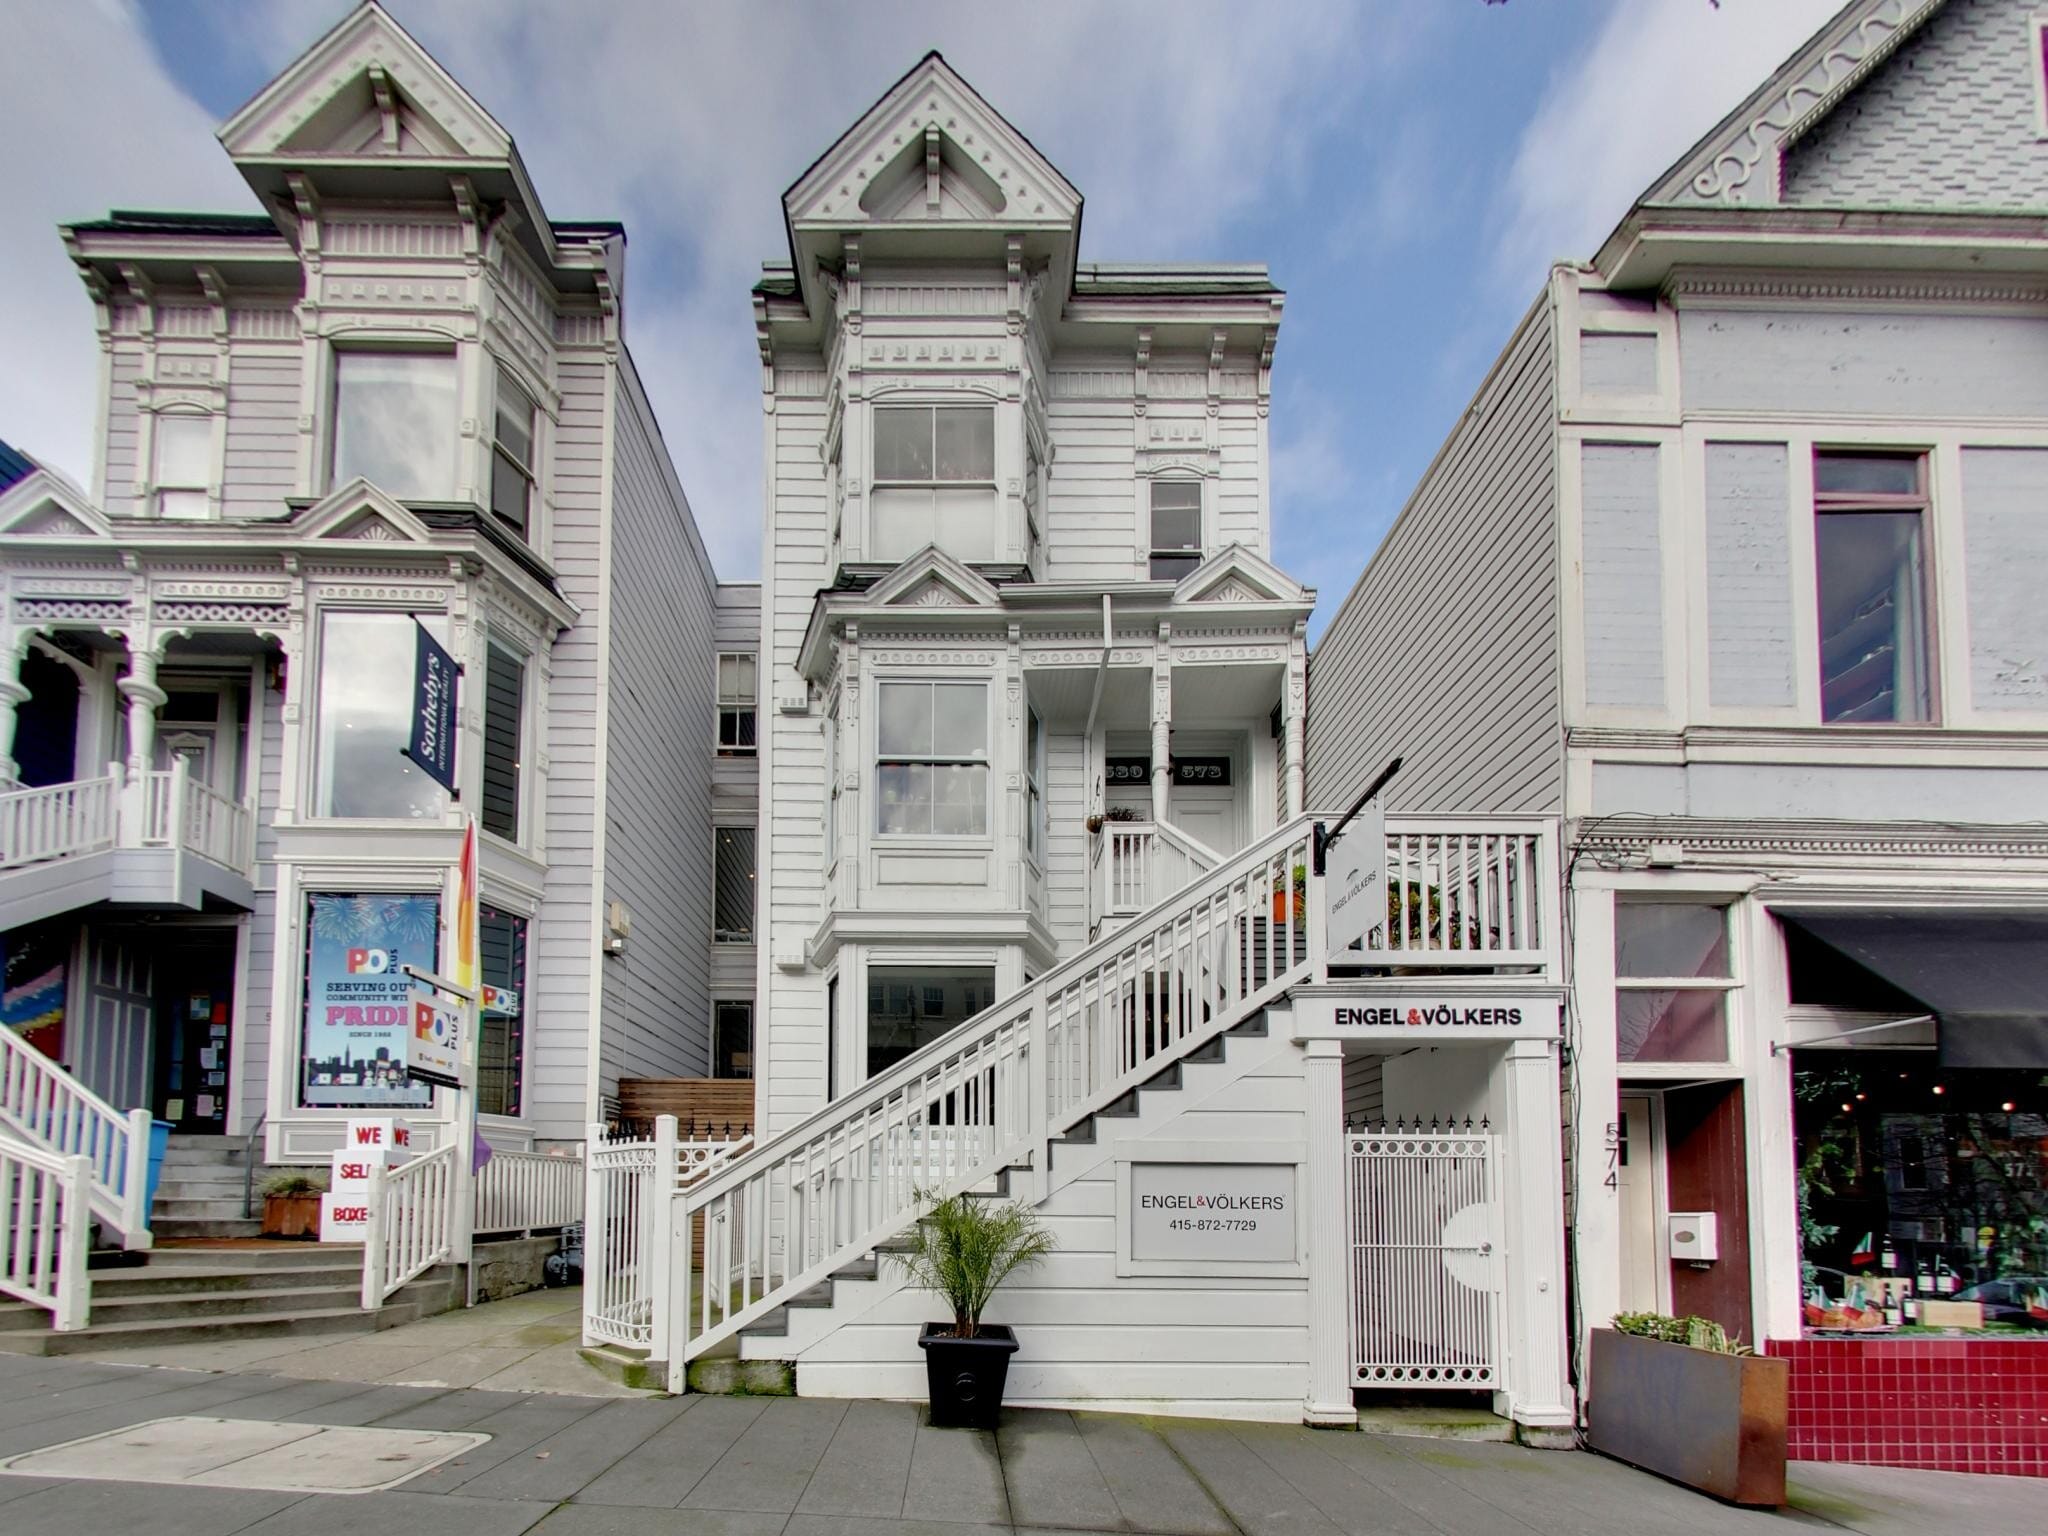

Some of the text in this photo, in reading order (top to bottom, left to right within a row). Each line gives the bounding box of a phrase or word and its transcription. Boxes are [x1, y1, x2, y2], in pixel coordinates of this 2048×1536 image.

[420, 652, 440, 762] Sotheby's
[438, 703, 449, 771] INTERNATIONAL
[389, 949, 398, 974] PLUS
[326, 982, 386, 992] SERVING
[356, 1127, 409, 1147] WE WE
[1169, 1219, 1257, 1231] 415-872-7729
